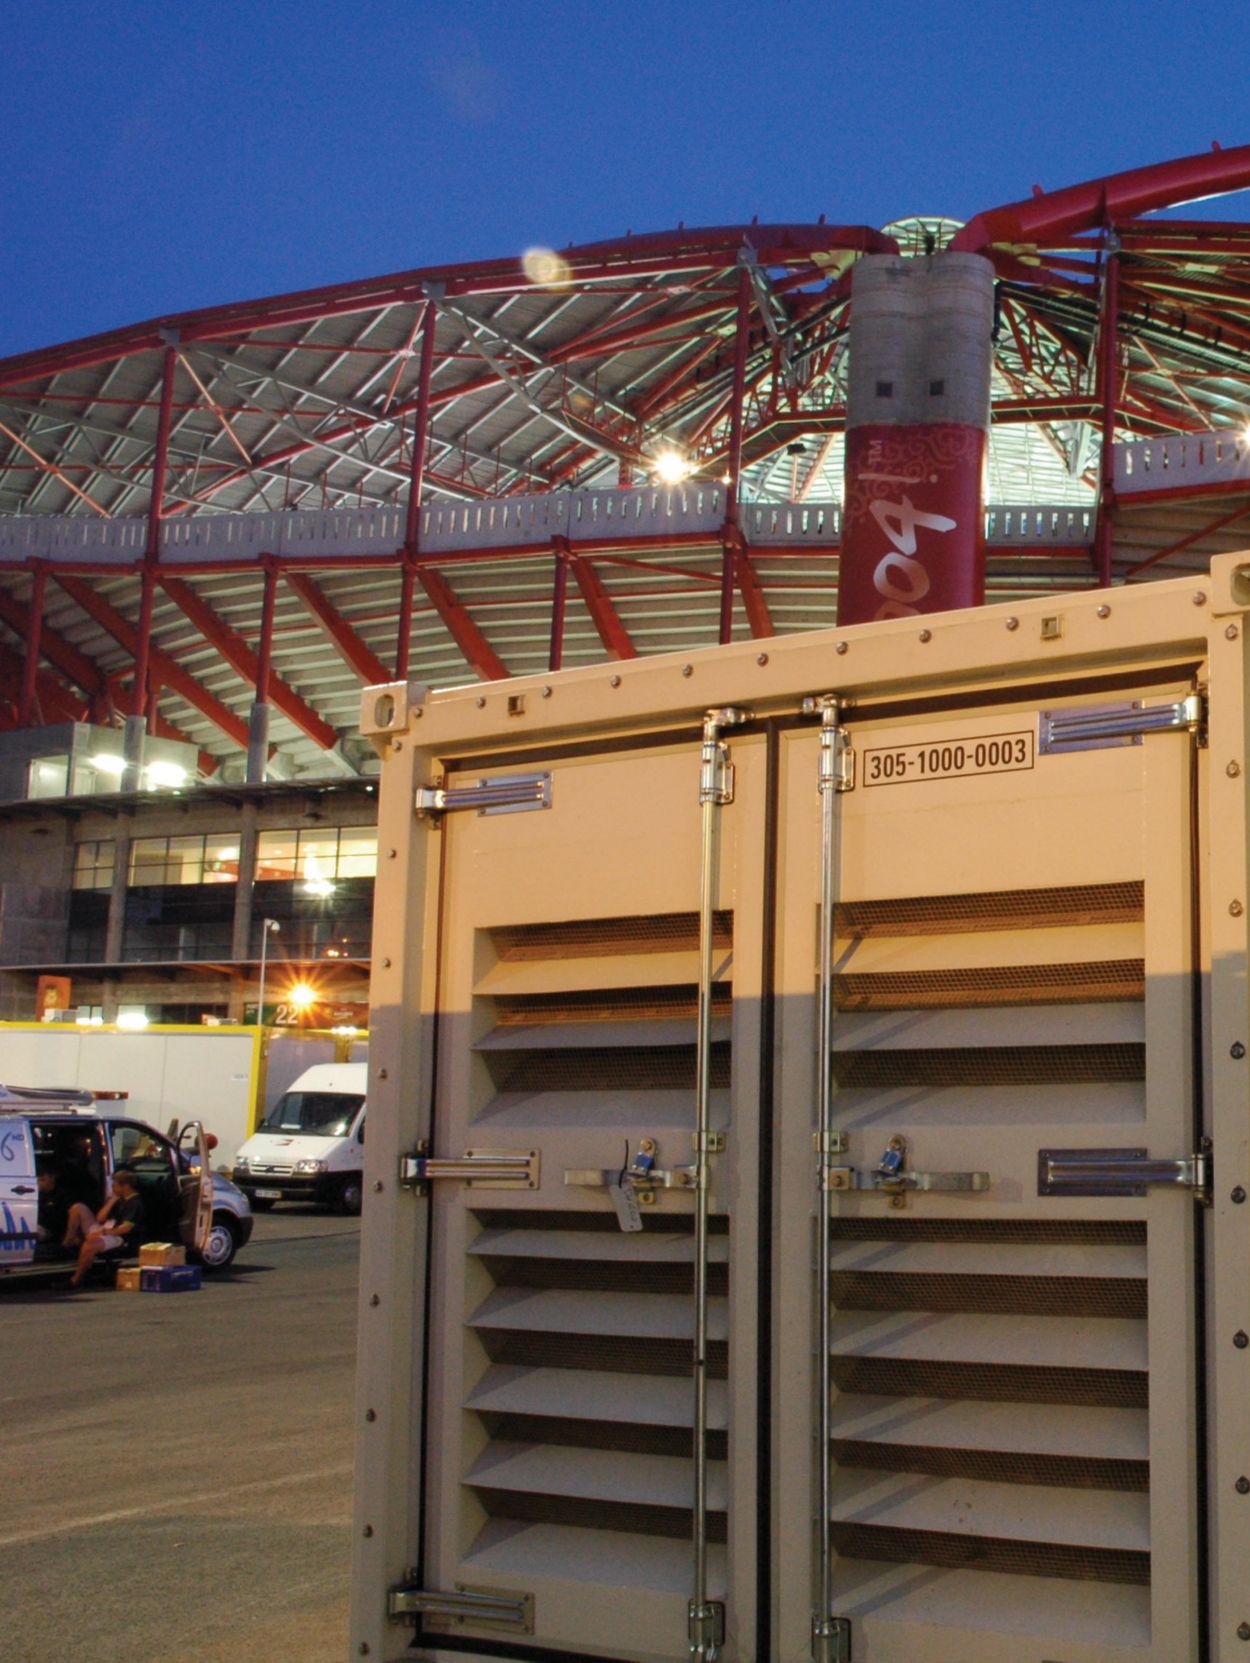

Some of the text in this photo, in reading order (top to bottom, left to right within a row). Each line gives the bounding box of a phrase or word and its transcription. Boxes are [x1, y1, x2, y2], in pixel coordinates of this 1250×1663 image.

[868, 440, 883, 464] TM
[870, 739, 1027, 779] 305-1000-0003
[275, 1004, 298, 1025] 22
